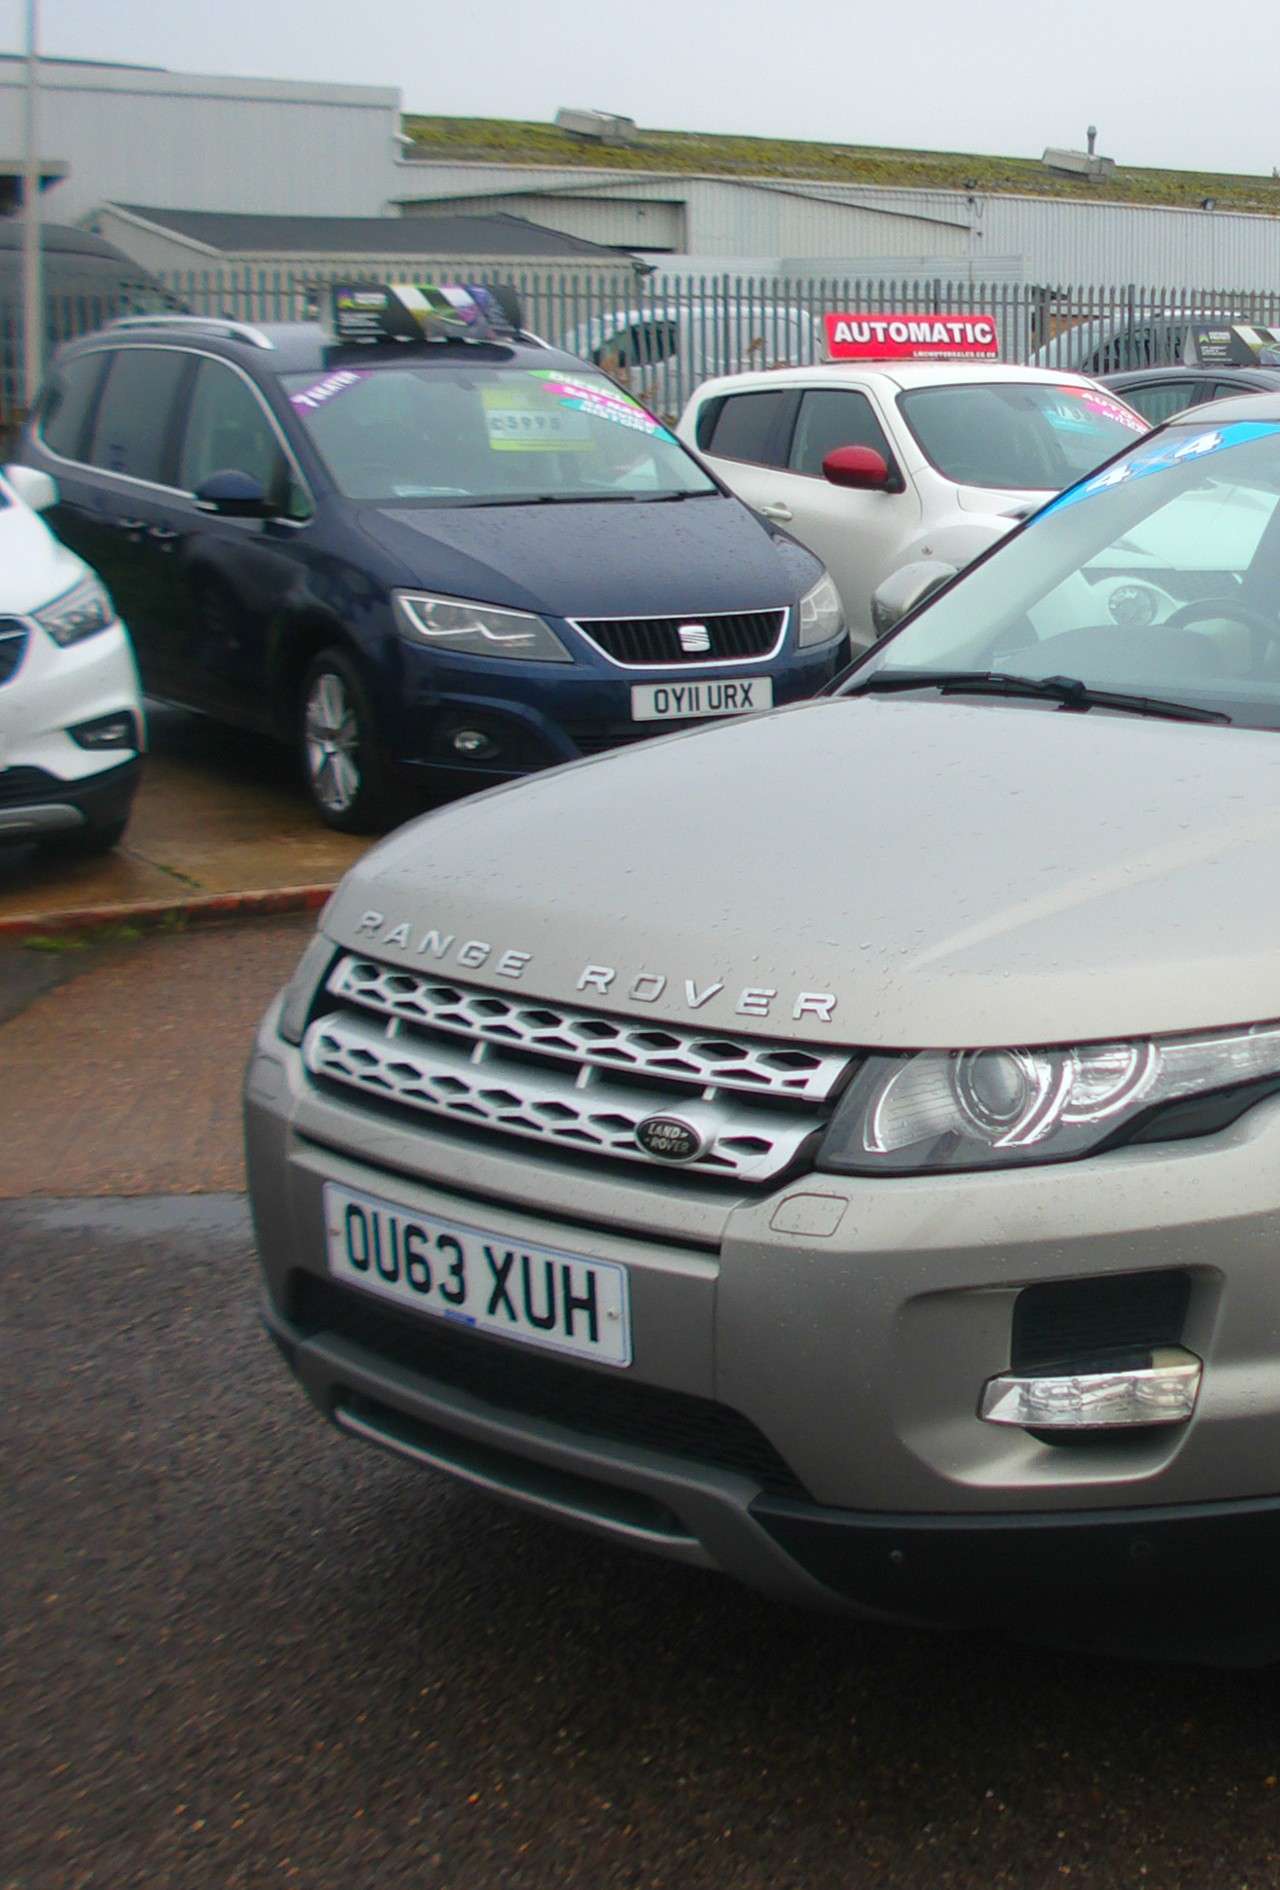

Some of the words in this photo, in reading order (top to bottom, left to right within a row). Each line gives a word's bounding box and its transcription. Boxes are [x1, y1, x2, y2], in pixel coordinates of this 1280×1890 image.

[834, 321, 993, 344] AUTOMATIC
[708, 682, 753, 710] URX
[355, 910, 534, 979] RANGE
[576, 964, 838, 1023] ROVER
[345, 1203, 466, 1306] OU63
[483, 1246, 598, 1342] XUH
